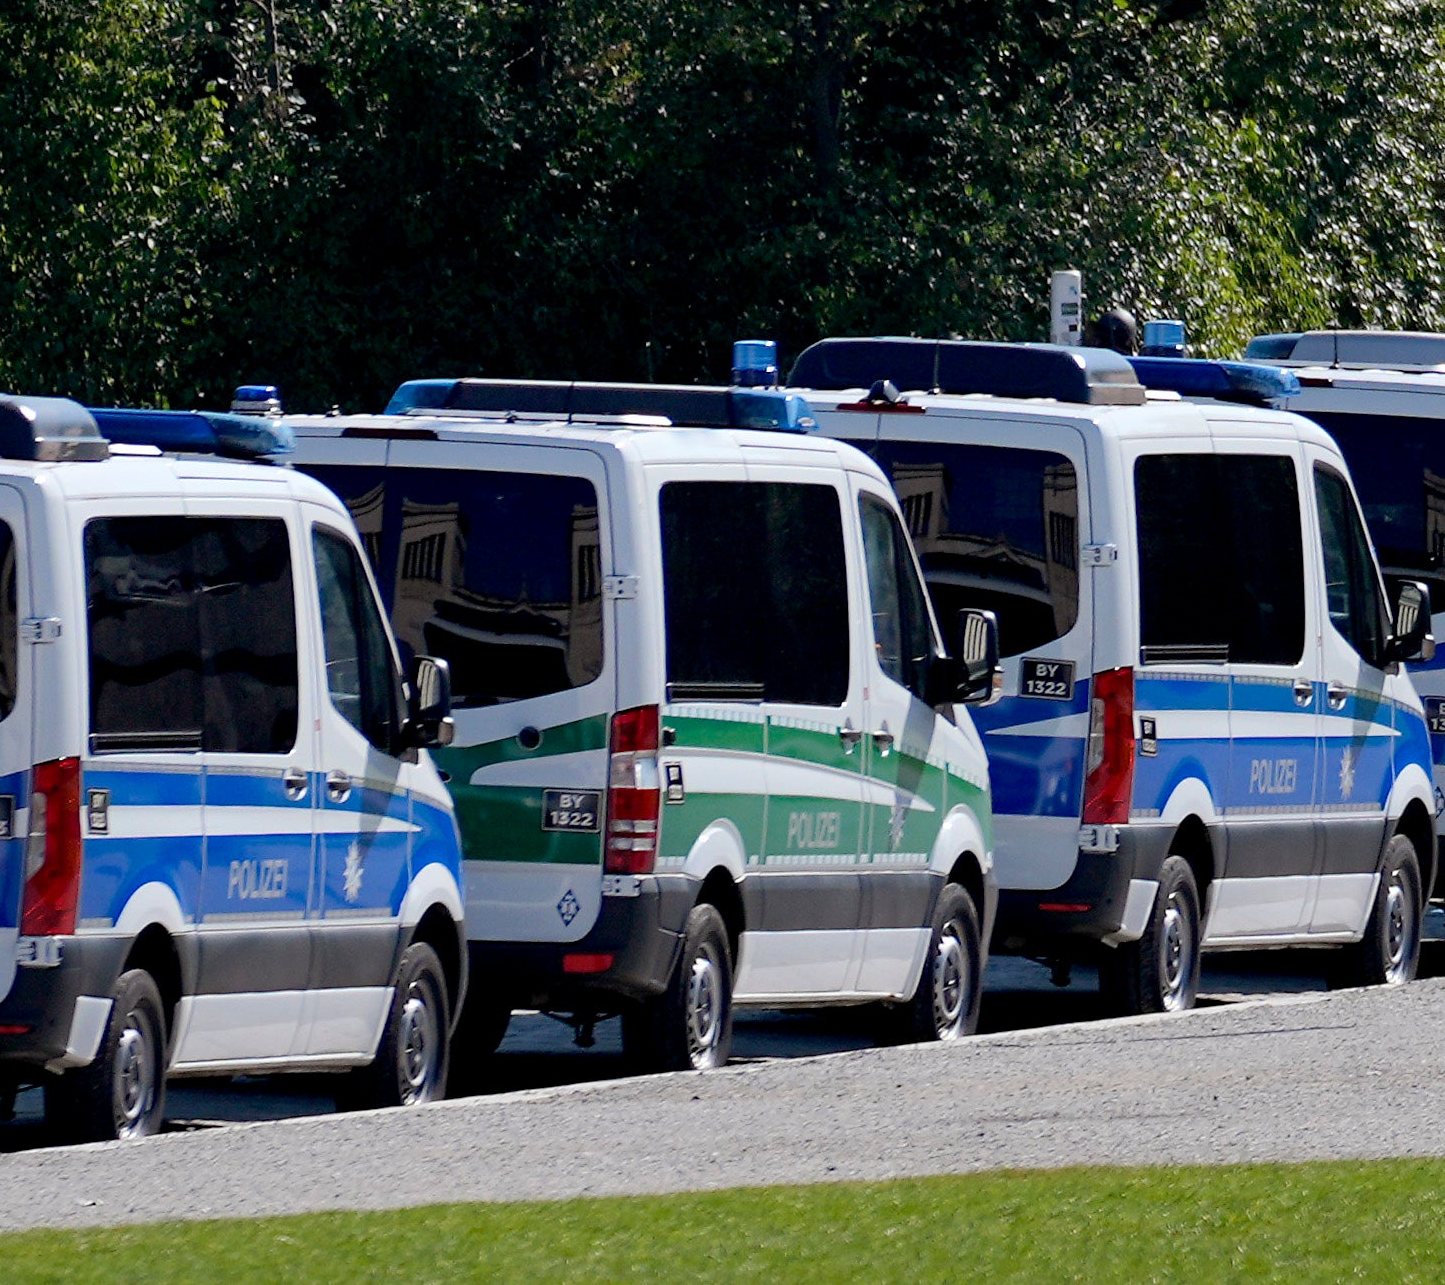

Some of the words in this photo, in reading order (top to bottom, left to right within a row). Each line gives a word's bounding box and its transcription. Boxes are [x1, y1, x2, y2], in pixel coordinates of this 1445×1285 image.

[1035, 663, 1059, 678] BY
[1026, 679, 1068, 696] 1322
[1249, 758, 1297, 794] POLIZEI
[559, 793, 586, 808] BY
[549, 810, 594, 827] 1322
[227, 858, 289, 900] POLIZEI
